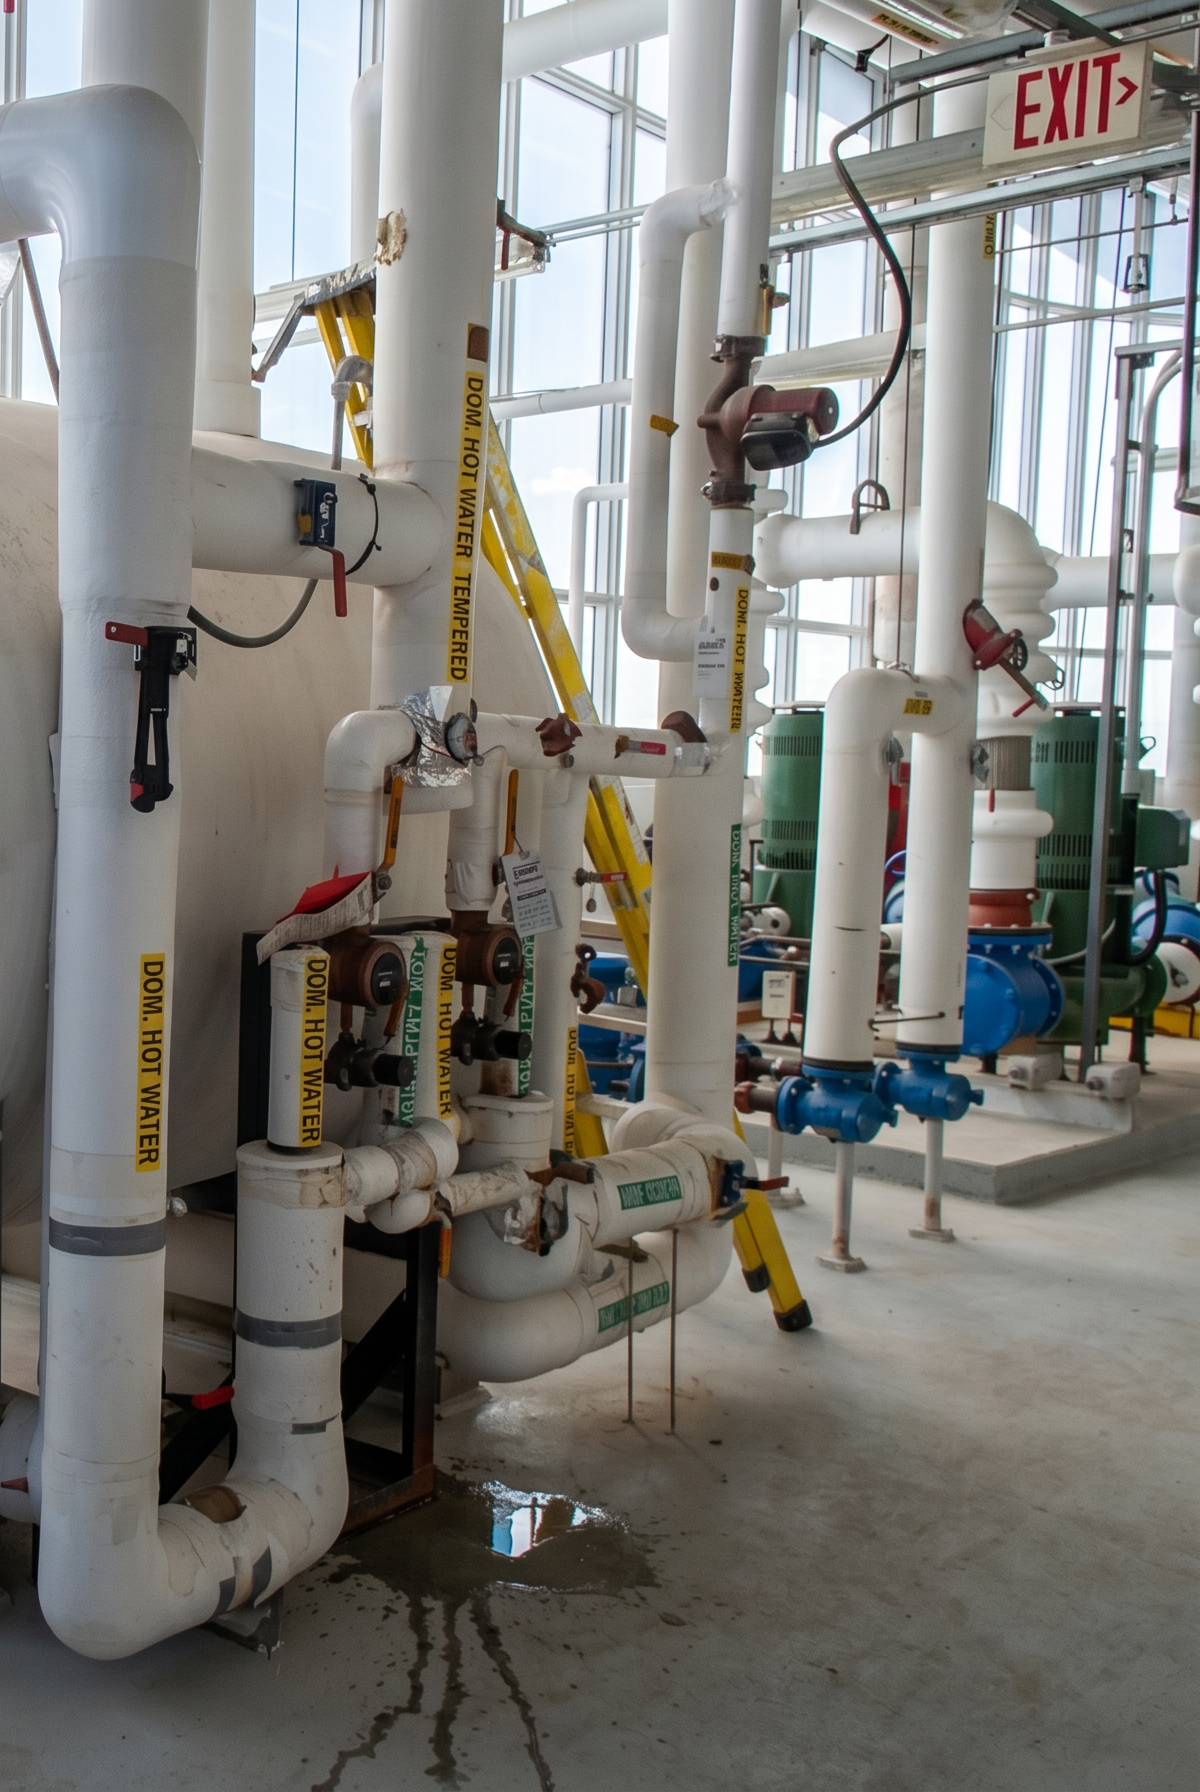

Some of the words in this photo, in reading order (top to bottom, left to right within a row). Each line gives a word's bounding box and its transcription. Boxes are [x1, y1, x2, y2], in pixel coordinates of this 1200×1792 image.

[1013, 53, 1121, 150] EXIT
[465, 376, 484, 431] DOM.
[462, 437, 480, 483] HOT
[455, 487, 477, 559] WATER
[450, 572, 472, 682] TEMPERED
[142, 960, 164, 1022] DOM.
[305, 958, 328, 1013] DOM.
[141, 1029, 163, 1076] HOT
[303, 1018, 325, 1062] HOT
[301, 1067, 323, 1144] WATER
[438, 1049, 453, 1116] WATER
[138, 1083, 161, 1166] WATER
